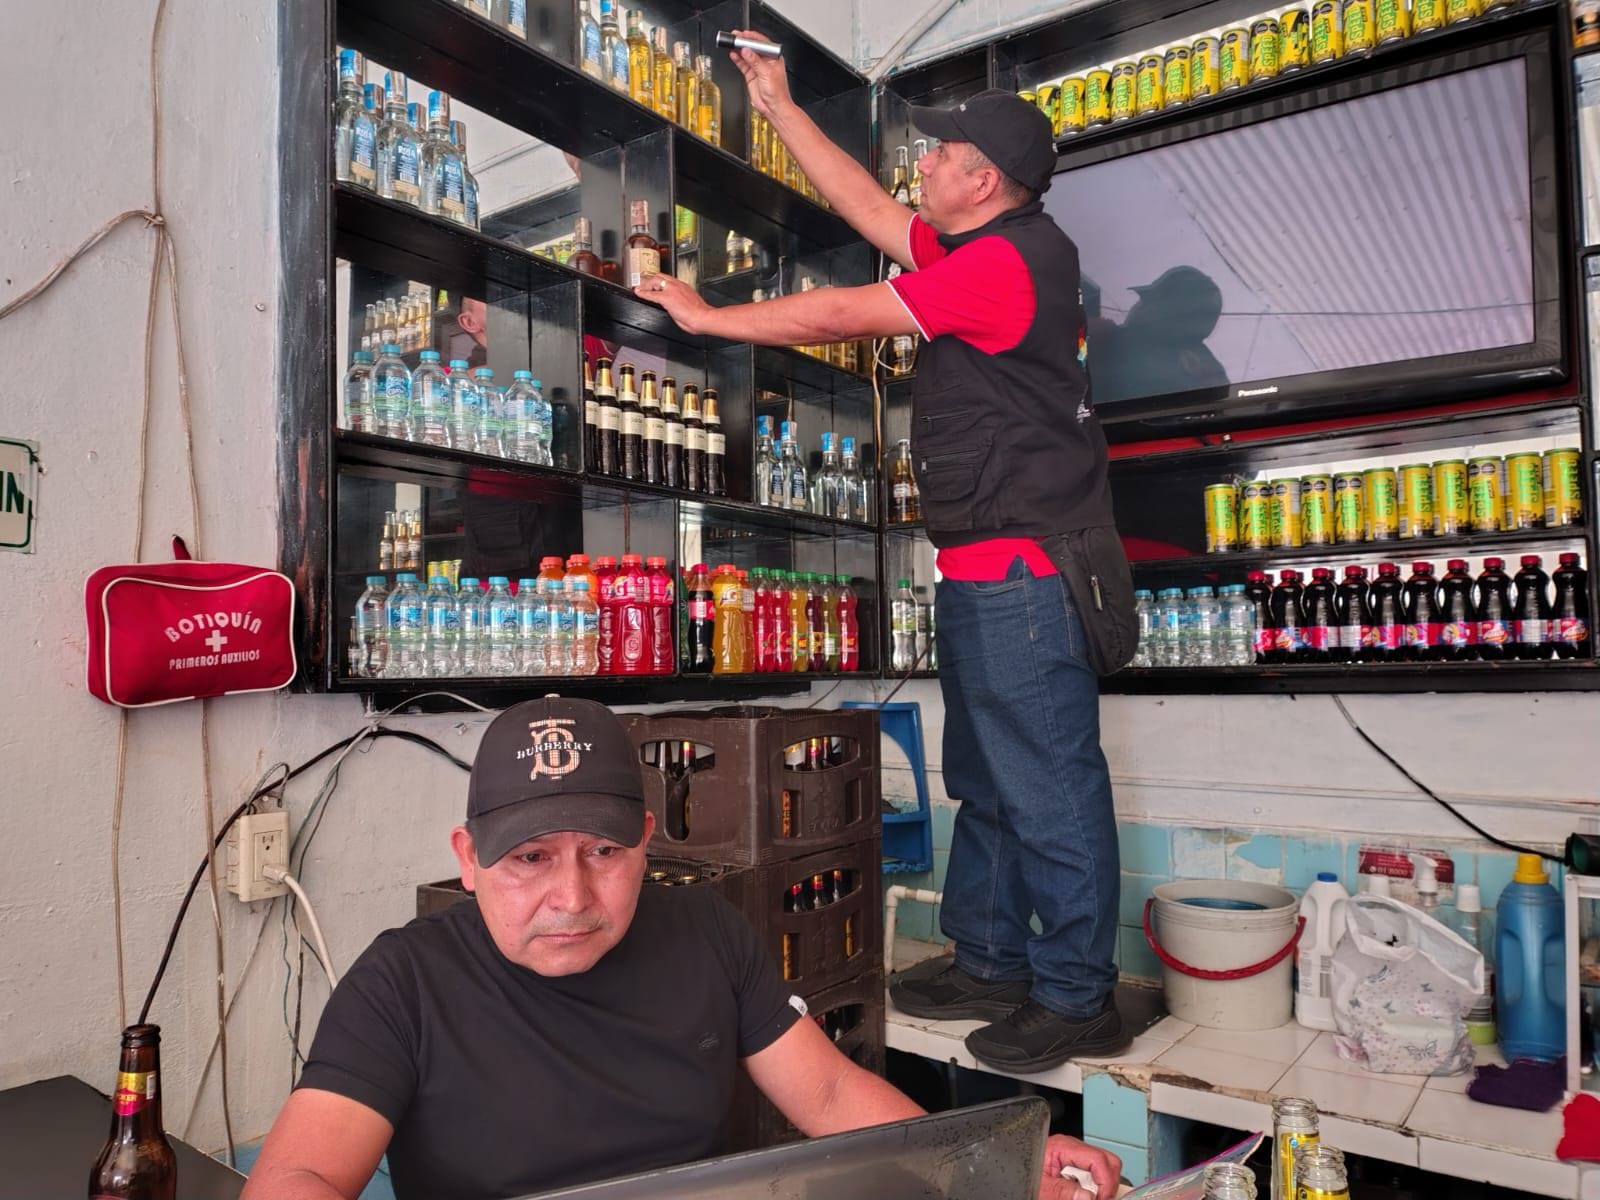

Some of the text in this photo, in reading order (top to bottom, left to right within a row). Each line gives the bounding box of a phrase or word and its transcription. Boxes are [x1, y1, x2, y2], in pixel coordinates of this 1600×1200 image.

[1261, 35, 1275, 66] SPEED
[1238, 386, 1278, 397] Panasonic
[164, 611, 262, 642] BOTIQUÍN
[169, 650, 260, 670] PRIMEROS AUXILIOS
[516, 741, 593, 760] BURBERRY
